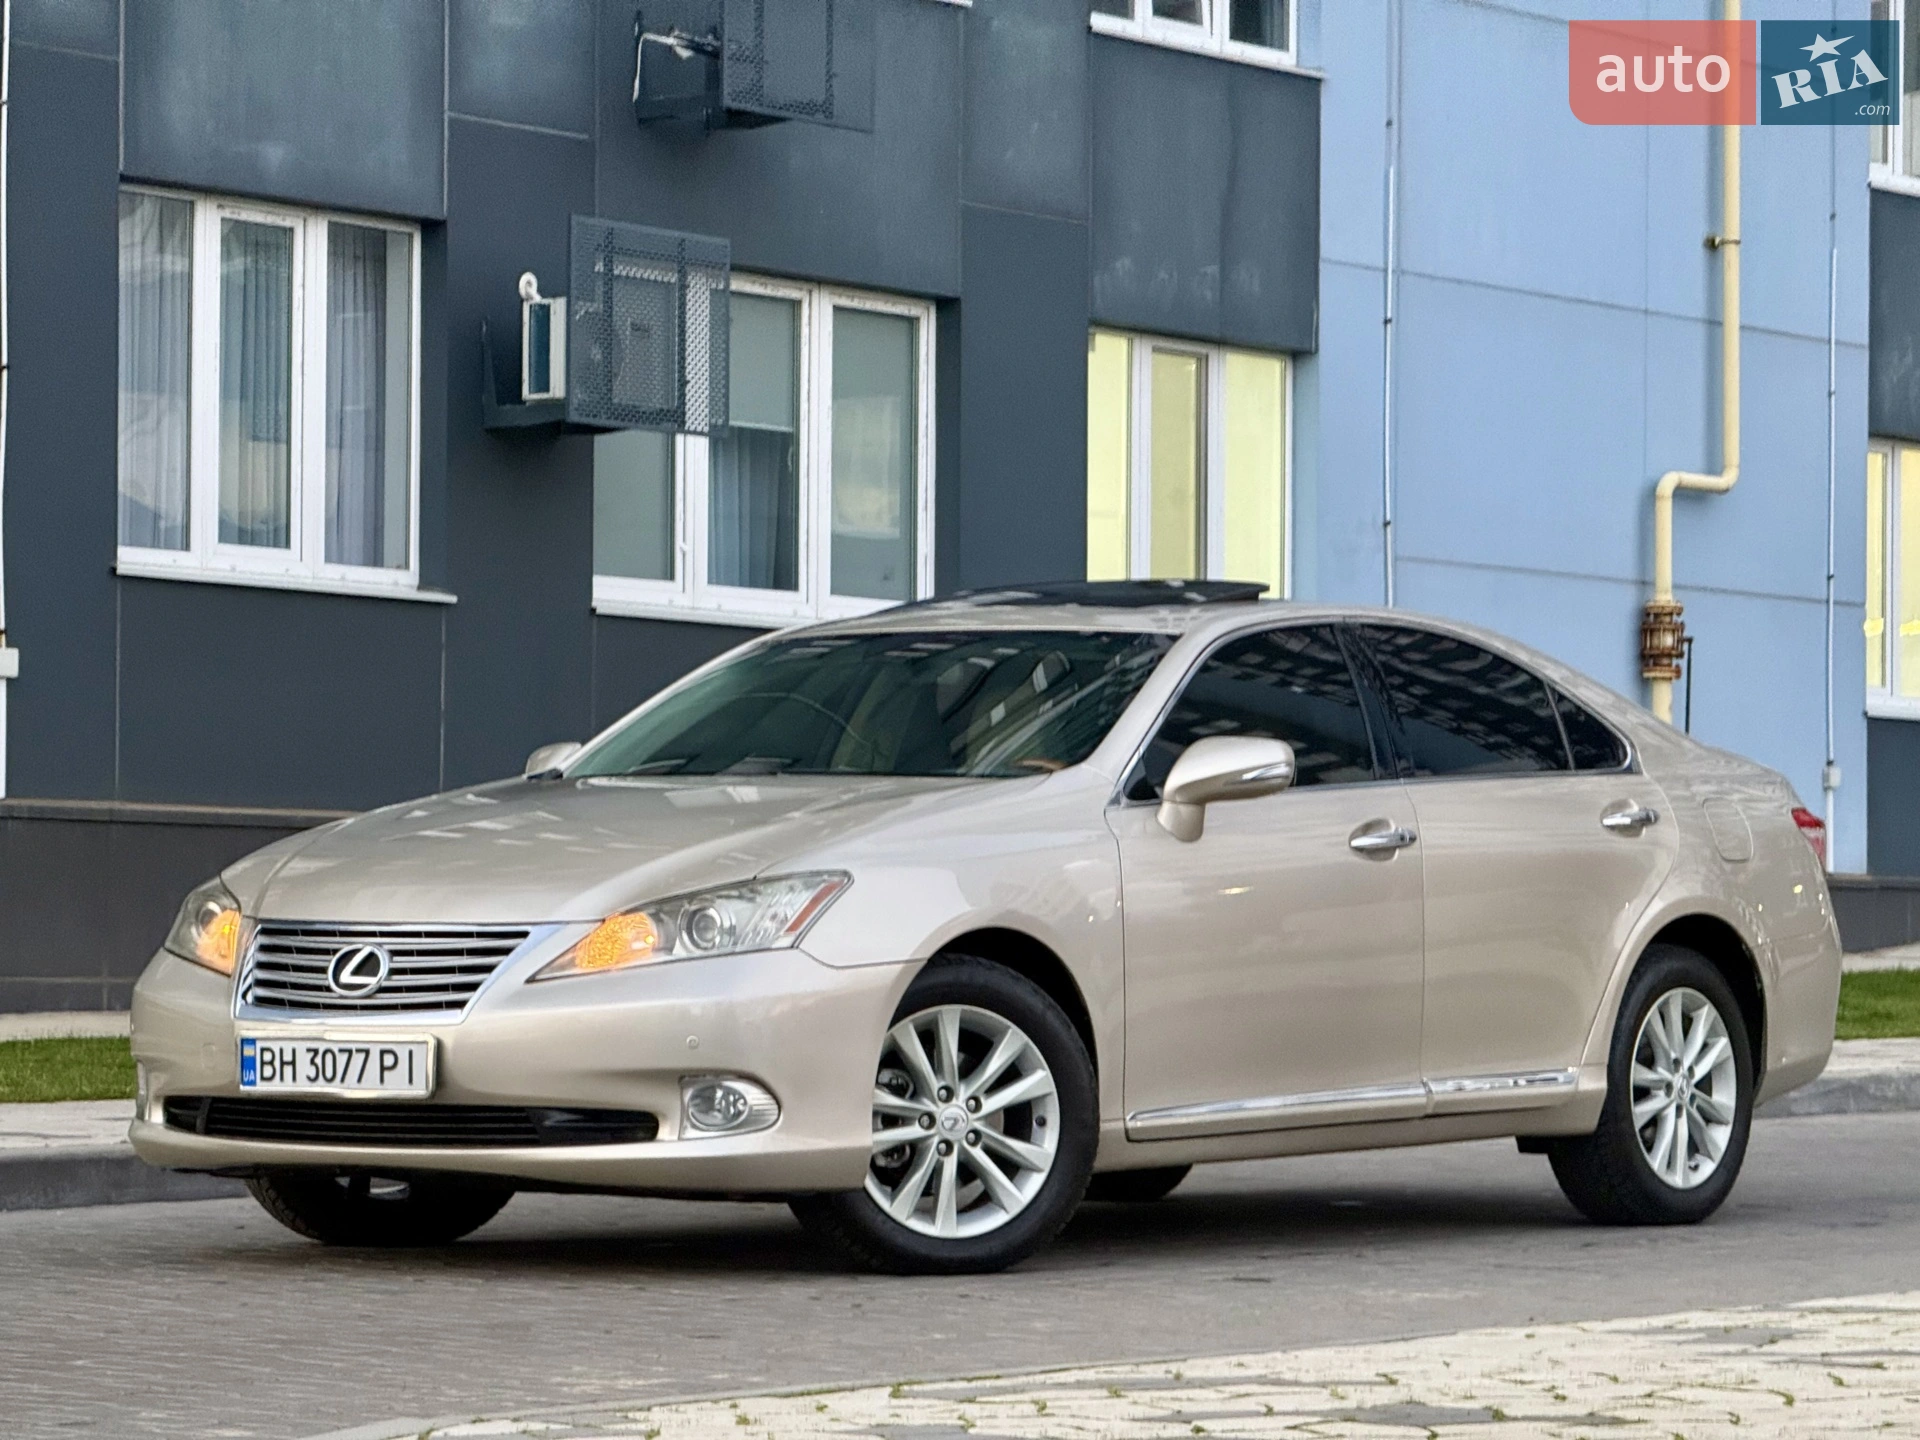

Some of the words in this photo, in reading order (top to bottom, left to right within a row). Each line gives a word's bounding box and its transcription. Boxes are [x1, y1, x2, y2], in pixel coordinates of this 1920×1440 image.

[243, 1069, 256, 1081] UA
[259, 1046, 297, 1083] BH
[305, 1047, 371, 1084] 3077
[379, 1049, 414, 1085] PI
